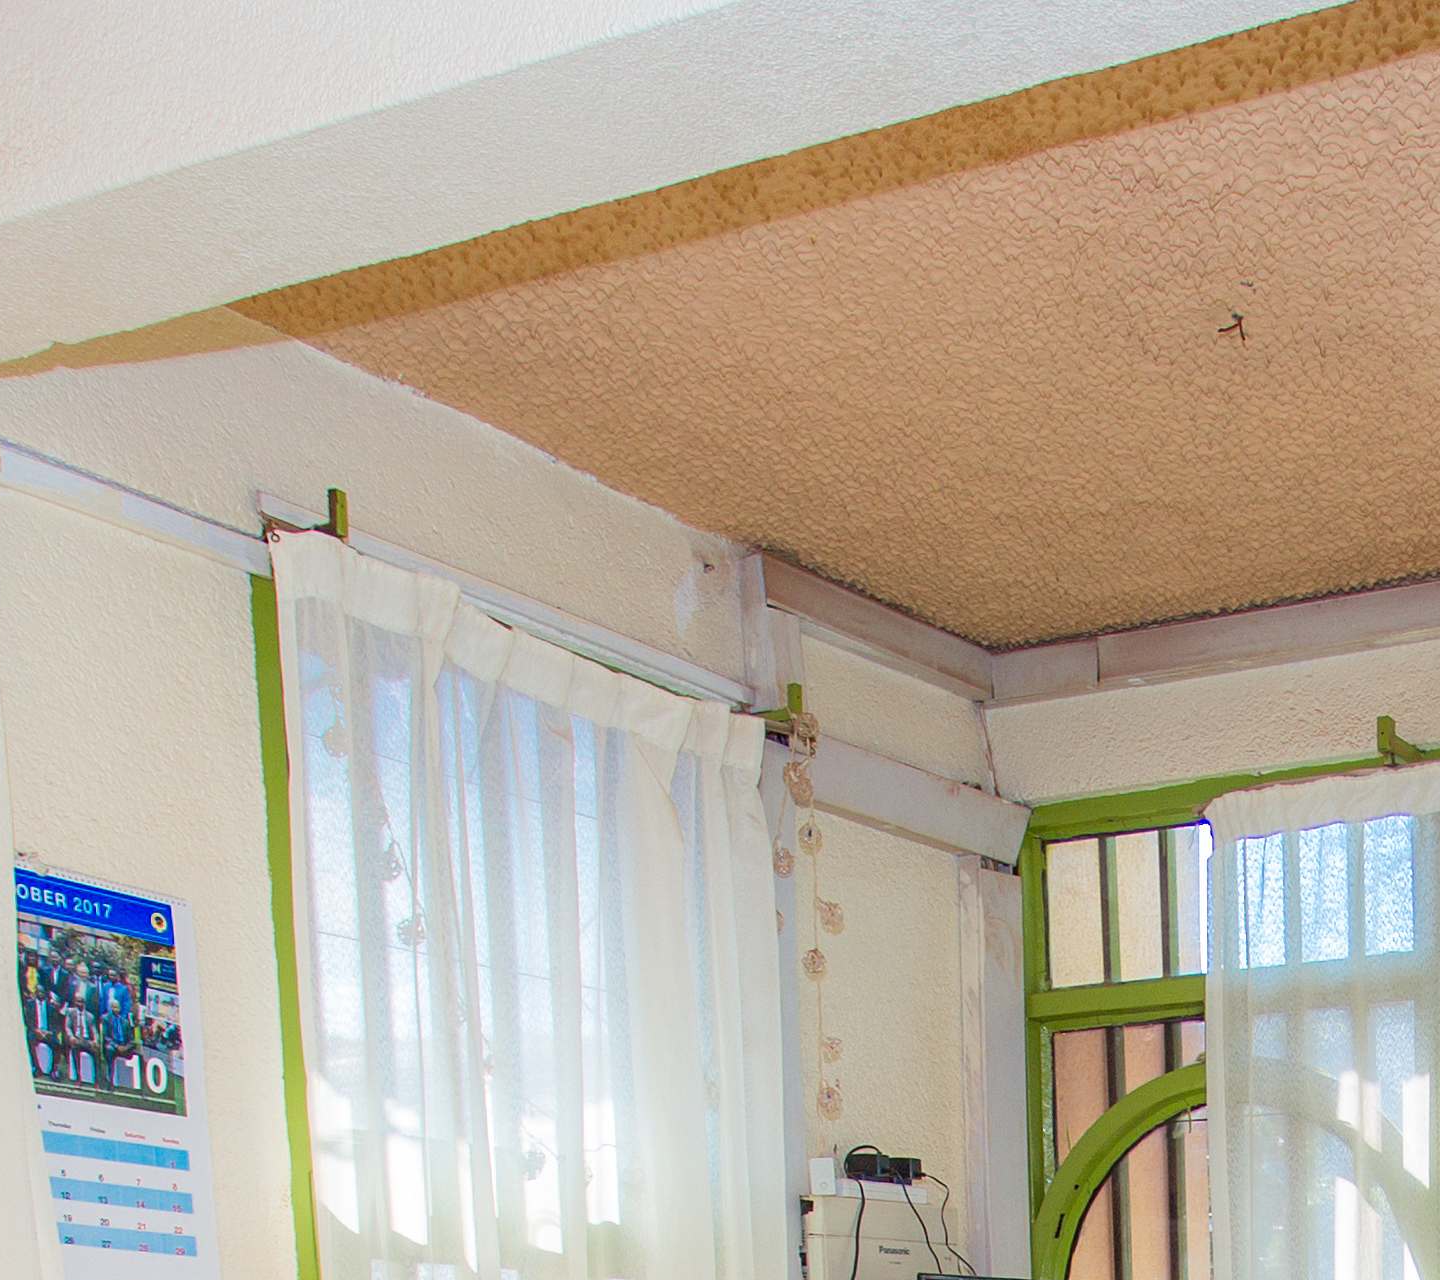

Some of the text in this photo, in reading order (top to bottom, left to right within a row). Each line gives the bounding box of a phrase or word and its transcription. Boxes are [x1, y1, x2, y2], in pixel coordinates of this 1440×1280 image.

[72, 897, 112, 918] 2017
[124, 1054, 168, 1094] 10
[136, 1178, 141, 1186] 7
[61, 1191, 182, 1213] 12 13 14 15
[63, 1214, 184, 1234] 19 20 21 22
[101, 1240, 112, 1249] 27
[175, 1247, 186, 1256] 29
[878, 1245, 911, 1256] Panasonic
